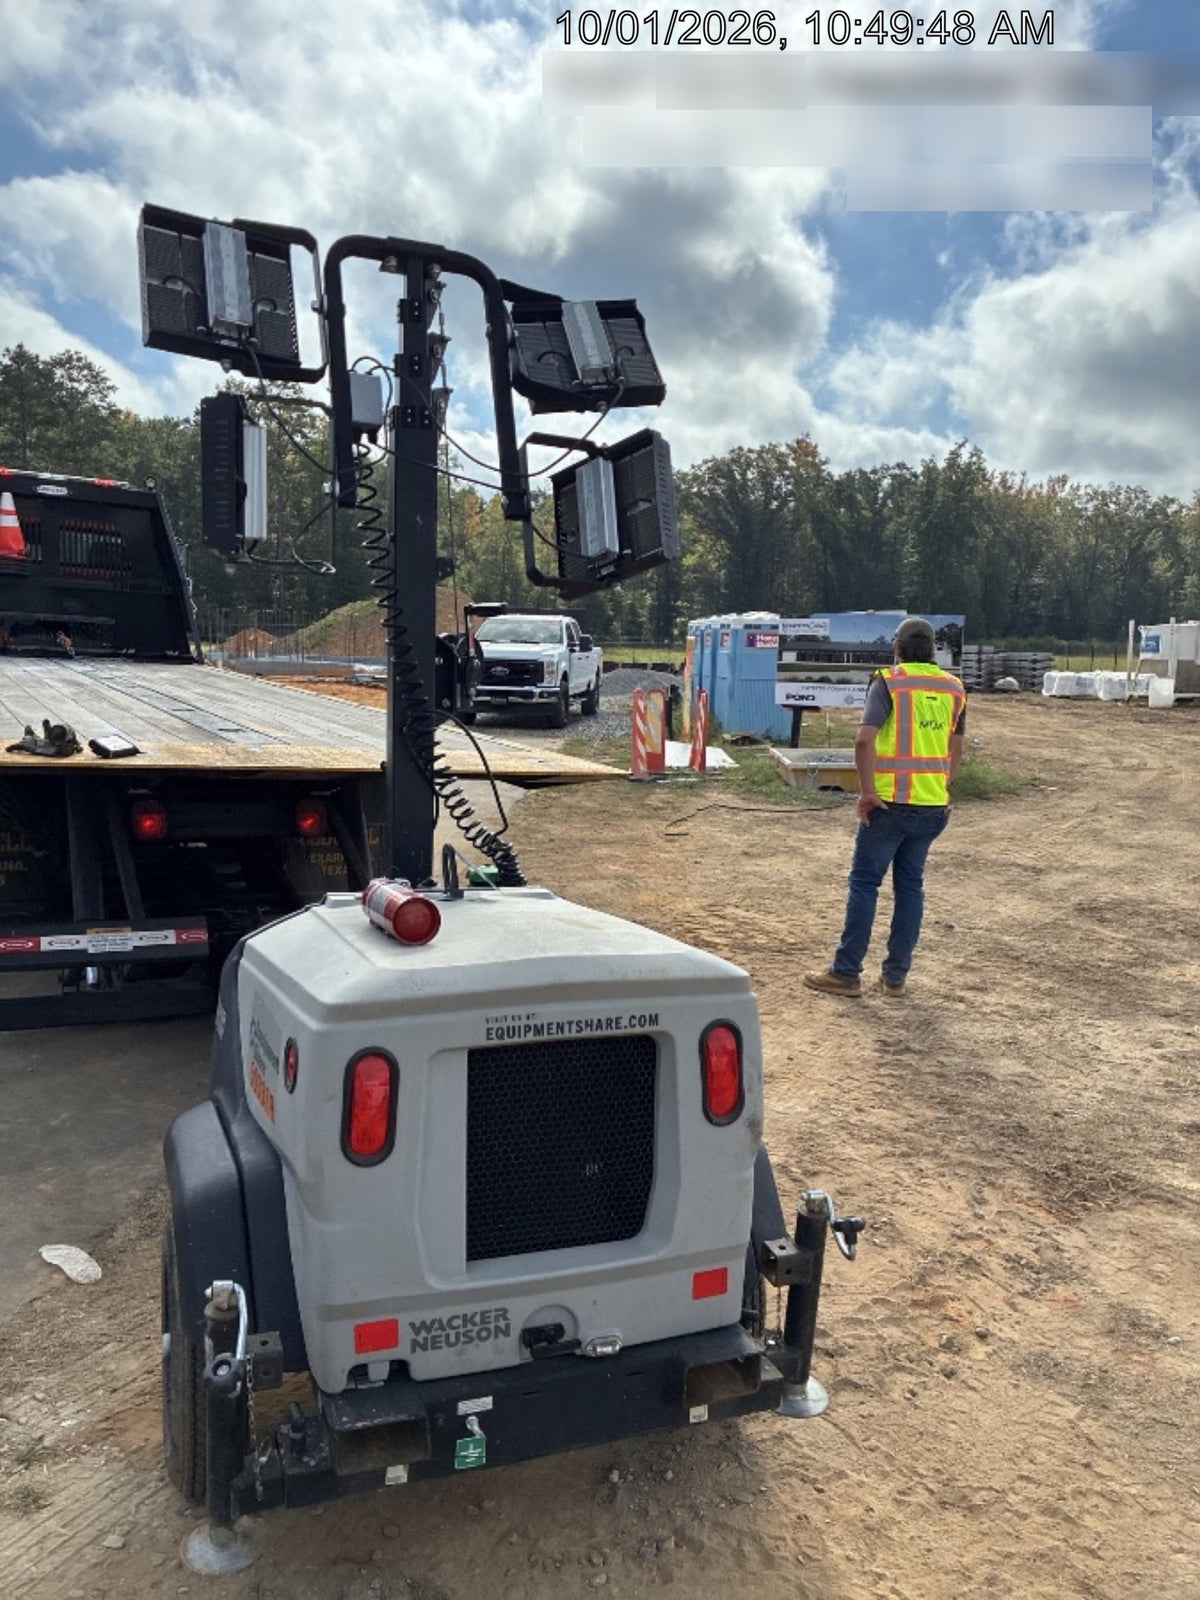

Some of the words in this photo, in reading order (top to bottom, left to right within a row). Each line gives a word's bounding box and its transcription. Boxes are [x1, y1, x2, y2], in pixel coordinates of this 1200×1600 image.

[486, 1013, 659, 1041] EQUIPMENTSHARE.COM
[408, 1307, 511, 1337] WACKER
[410, 1322, 511, 1354] NEUSON
